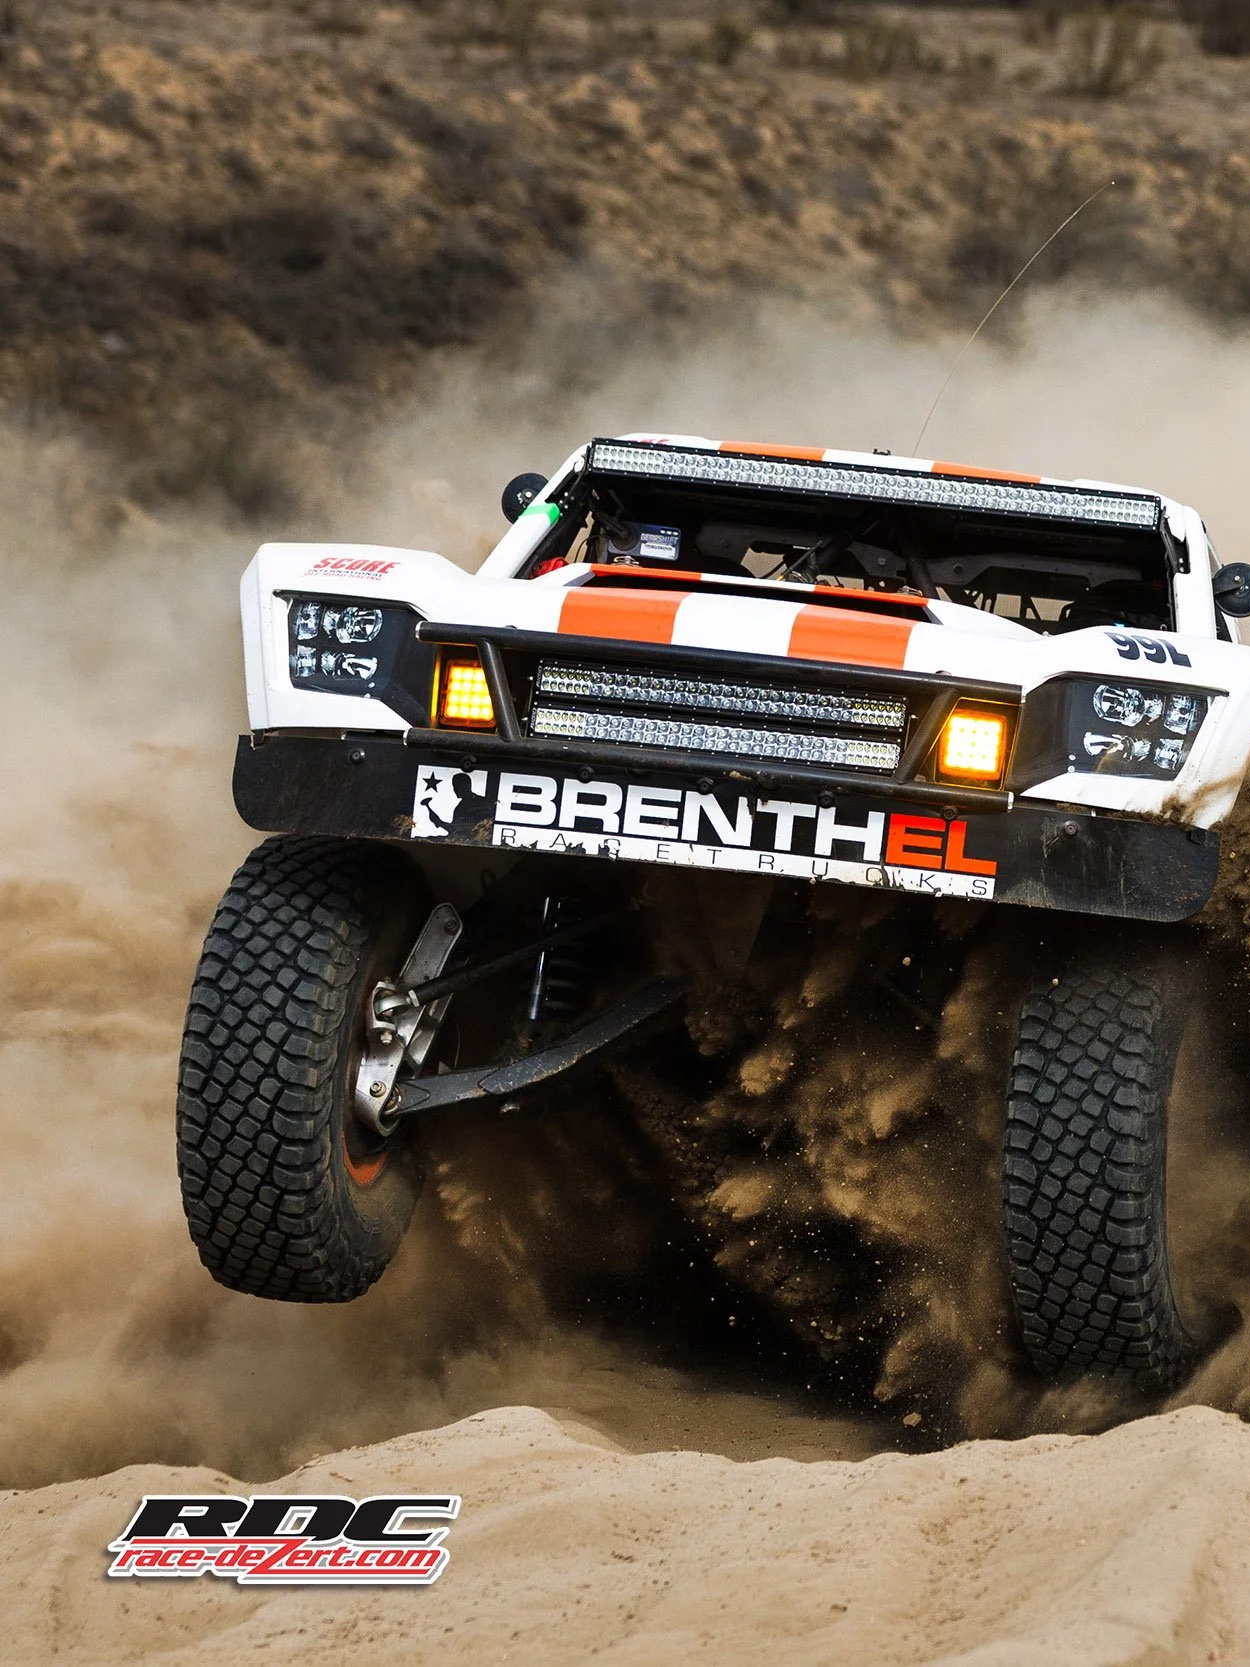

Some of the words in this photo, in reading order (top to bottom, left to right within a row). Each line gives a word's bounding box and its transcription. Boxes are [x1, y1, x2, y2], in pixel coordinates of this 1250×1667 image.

[313, 557, 401, 574] SCORE
[1103, 631, 1192, 668] 99L
[493, 772, 998, 876] BRENTHEL
